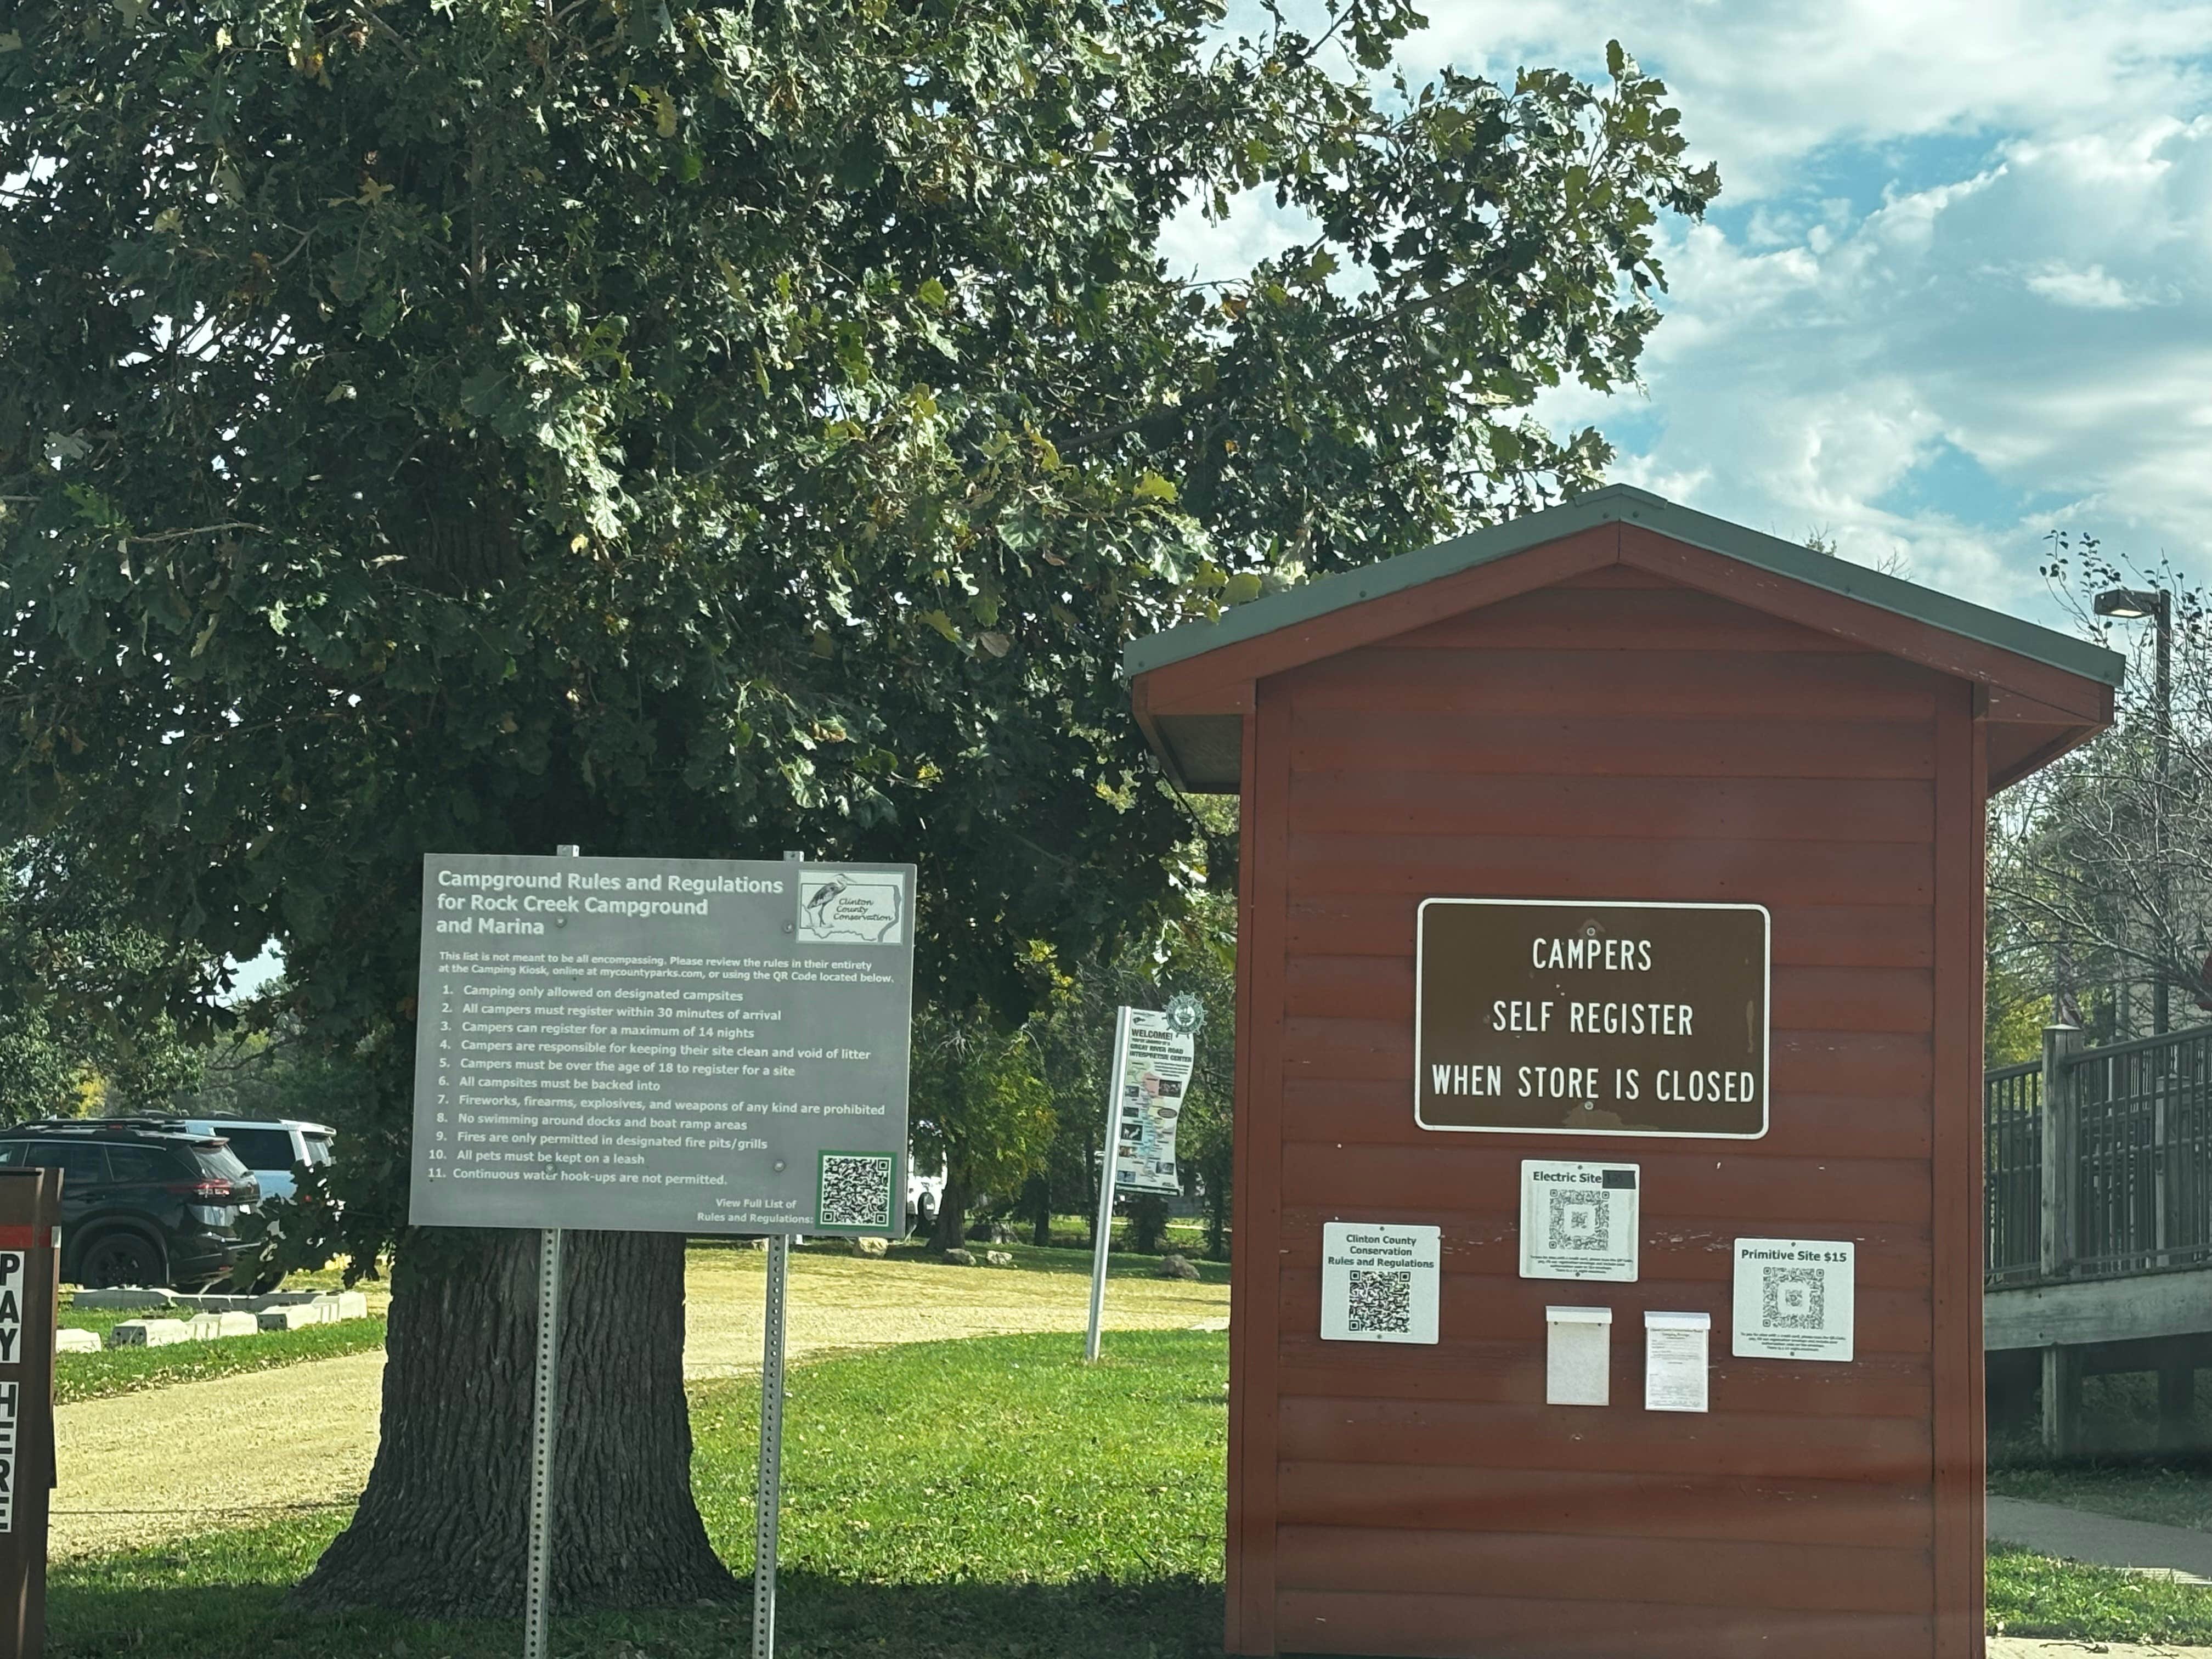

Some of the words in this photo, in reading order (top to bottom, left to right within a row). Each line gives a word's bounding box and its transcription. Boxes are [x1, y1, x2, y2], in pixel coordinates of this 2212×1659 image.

[439, 870, 561, 891] Campground
[568, 873, 621, 890] Rules
[626, 874, 662, 891] and
[668, 875, 783, 895] Regulations
[438, 893, 465, 910] for
[471, 894, 518, 911] Rock
[524, 895, 579, 913] Creek
[585, 896, 708, 917] Campground
[436, 917, 472, 933] and
[478, 917, 544, 935] Marina
[1533, 938, 1651, 970] CAMPERS
[439, 964, 449, 973] at
[452, 964, 469, 973] the
[471, 964, 516, 976] Camping
[520, 966, 549, 976] Kiosk,
[553, 966, 584, 975] online
[600, 968, 706, 979] mycountyparks.com,
[723, 969, 750, 981] using
[753, 970, 770, 980] the
[773, 971, 788, 982] QR
[792, 972, 817, 981] Code
[820, 972, 857, 982] located
[860, 973, 894, 983] below.
[443, 984, 453, 995] 1.
[464, 985, 515, 998] Camping
[518, 986, 544, 998] only
[547, 986, 592, 997] allowed
[614, 988, 679, 1001] designated
[683, 990, 743, 1003] campsites
[442, 1003, 452, 1013] 2.
[462, 1003, 478, 1013] All
[481, 1006, 531, 1016] campers
[535, 1006, 564, 1015] must
[568, 1006, 614, 1018] register
[617, 1007, 654, 1017] within
[658, 1007, 673, 1018] 30
[676, 1008, 724, 1019] minutes
[727, 1009, 740, 1019] of
[743, 1009, 781, 1020] arrival
[1493, 1001, 1553, 1031] SELF
[1571, 1002, 1692, 1035] REGISTER
[441, 1021, 451, 1031] 3.
[462, 1021, 514, 1034] Campers
[517, 1024, 537, 1032] can
[541, 1023, 587, 1036] register
[590, 1024, 607, 1034] for
[621, 1025, 679, 1036] maximum
[683, 1026, 696, 1037] of
[699, 1027, 713, 1037] 14
[718, 1027, 754, 1040] nights
[440, 1040, 450, 1049] 4.
[461, 1040, 512, 1052] Campers
[516, 1043, 535, 1051] are
[539, 1042, 606, 1053] responsible
[610, 1042, 627, 1053] for
[630, 1043, 676, 1057] keeping
[680, 1045, 709, 1056] their
[712, 1045, 733, 1056] site
[737, 1046, 768, 1057] clean
[772, 1047, 794, 1058] and
[798, 1048, 822, 1058] void
[826, 1048, 839, 1059] of
[842, 1048, 871, 1060] litter
[439, 1076, 449, 1086] 6.
[459, 1076, 475, 1086] All
[478, 1077, 537, 1088] campsites
[541, 1079, 571, 1088] must
[574, 1079, 588, 1089] be
[592, 1079, 633, 1090] backed
[637, 1080, 660, 1091] into
[1432, 1064, 1500, 1096] WHEN
[1519, 1066, 1599, 1098] STORE
[1617, 1069, 1639, 1099] IS
[1657, 1070, 1753, 1102] CLOSED
[438, 1094, 449, 1104] 7.
[459, 1094, 520, 1108] Fireworks,
[524, 1096, 577, 1109] firearms,
[580, 1097, 646, 1111] explosives,
[650, 1099, 671, 1109] and
[675, 1102, 728, 1113] weapons
[731, 1101, 744, 1111] of
[747, 1104, 768, 1115] any
[772, 1102, 797, 1113] kind
[824, 1104, 884, 1116] prohibited
[437, 1113, 448, 1122] 8.
[459, 1113, 475, 1123] No
[478, 1113, 538, 1127] swimming
[542, 1115, 583, 1126] around
[587, 1115, 621, 1126] docks
[624, 1117, 646, 1127] and
[650, 1118, 677, 1128] boat
[680, 1120, 711, 1131] ramp
[714, 1121, 747, 1131] areas
[436, 1131, 447, 1141] 9.
[458, 1131, 486, 1142] Fires
[489, 1134, 508, 1142] are
[512, 1132, 537, 1146] only
[540, 1133, 598, 1146] permitted
[602, 1135, 612, 1145] in
[616, 1135, 681, 1148] designated
[685, 1137, 706, 1148] fire
[709, 1137, 767, 1151] pits/grills
[429, 1149, 447, 1159] 10.
[457, 1149, 472, 1160] All
[476, 1151, 501, 1162] pets
[505, 1152, 534, 1161] must
[538, 1151, 552, 1162] be
[556, 1152, 582, 1165] kept
[585, 1155, 599, 1163] on
[603, 1155, 610, 1163] a
[614, 1153, 644, 1164] leash
[428, 1167, 446, 1178] 11.
[453, 1168, 520, 1180] Continuous
[523, 1171, 557, 1181] water
[561, 1170, 616, 1184] hook-ups
[619, 1175, 639, 1183] are
[642, 1173, 662, 1183] not
[665, 1173, 727, 1186] permitted.
[1533, 1171, 1577, 1182] Electric
[1579, 1173, 1602, 1183] Site
[716, 1199, 741, 1207] View
[744, 1198, 761, 1208] Full
[765, 1199, 783, 1208] List
[786, 1200, 797, 1209] of
[698, 1212, 725, 1222] Rules
[728, 1213, 747, 1222] and
[750, 1214, 813, 1224] Regulations:
[1346, 1234, 1380, 1243] Clinton
[1383, 1236, 1417, 1247] County
[1350, 1246, 1412, 1256] Conservation
[1741, 1249, 1795, 1260] Primitive
[1797, 1250, 1821, 1261] Site
[1824, 1252, 1847, 1262] $15
[1328, 1256, 1355, 1265] Rules
[1356, 1258, 1374, 1266] and
[1377, 1258, 1434, 1268] Regulations
[0, 1253, 20, 1361] PAY
